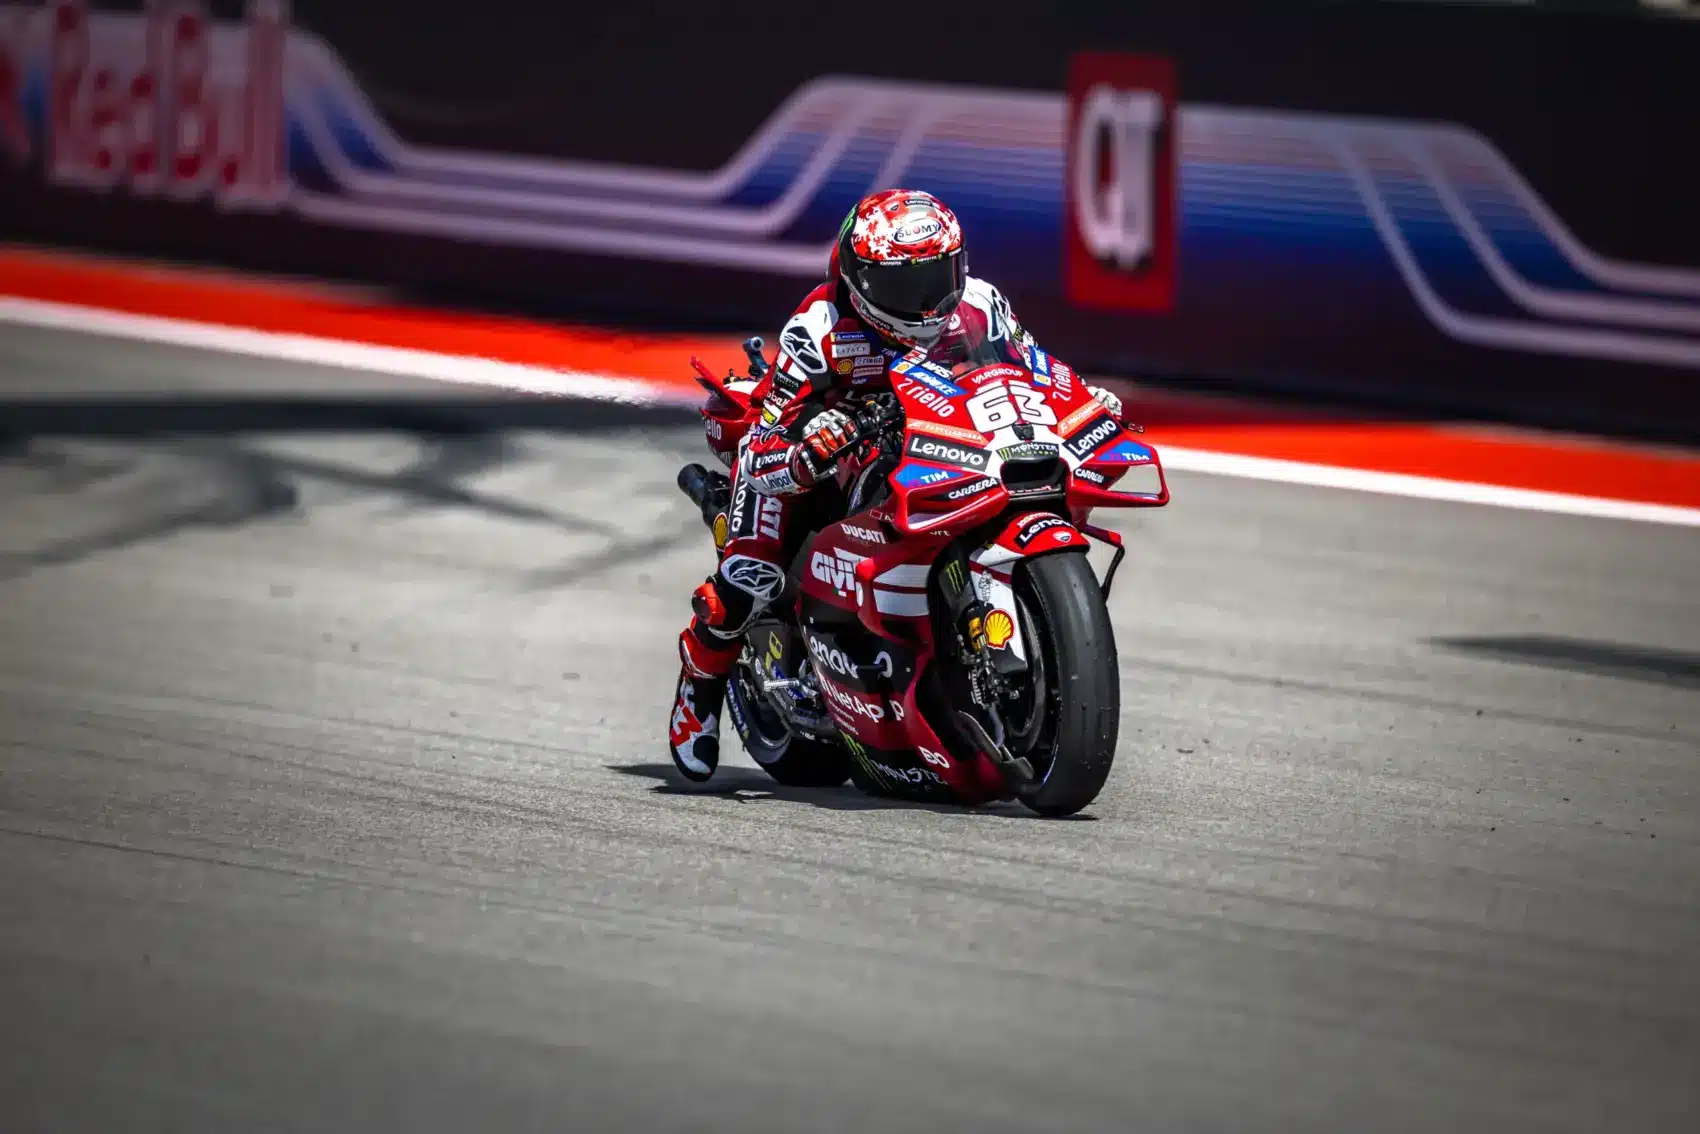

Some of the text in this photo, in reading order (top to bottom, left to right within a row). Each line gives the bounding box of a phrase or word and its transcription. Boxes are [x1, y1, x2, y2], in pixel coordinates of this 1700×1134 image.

[50, 2, 286, 196] Red Bull
[898, 223, 940, 239] SUOMY
[905, 385, 955, 418] riello
[965, 379, 1058, 434] 63
[1011, 443, 1059, 454] MONSTER
[1068, 419, 1117, 457] Lenovo
[911, 438, 984, 466] Lenovo
[920, 471, 950, 484] TIM
[948, 477, 998, 500] CARRERA
[840, 523, 887, 545] DUCATI
